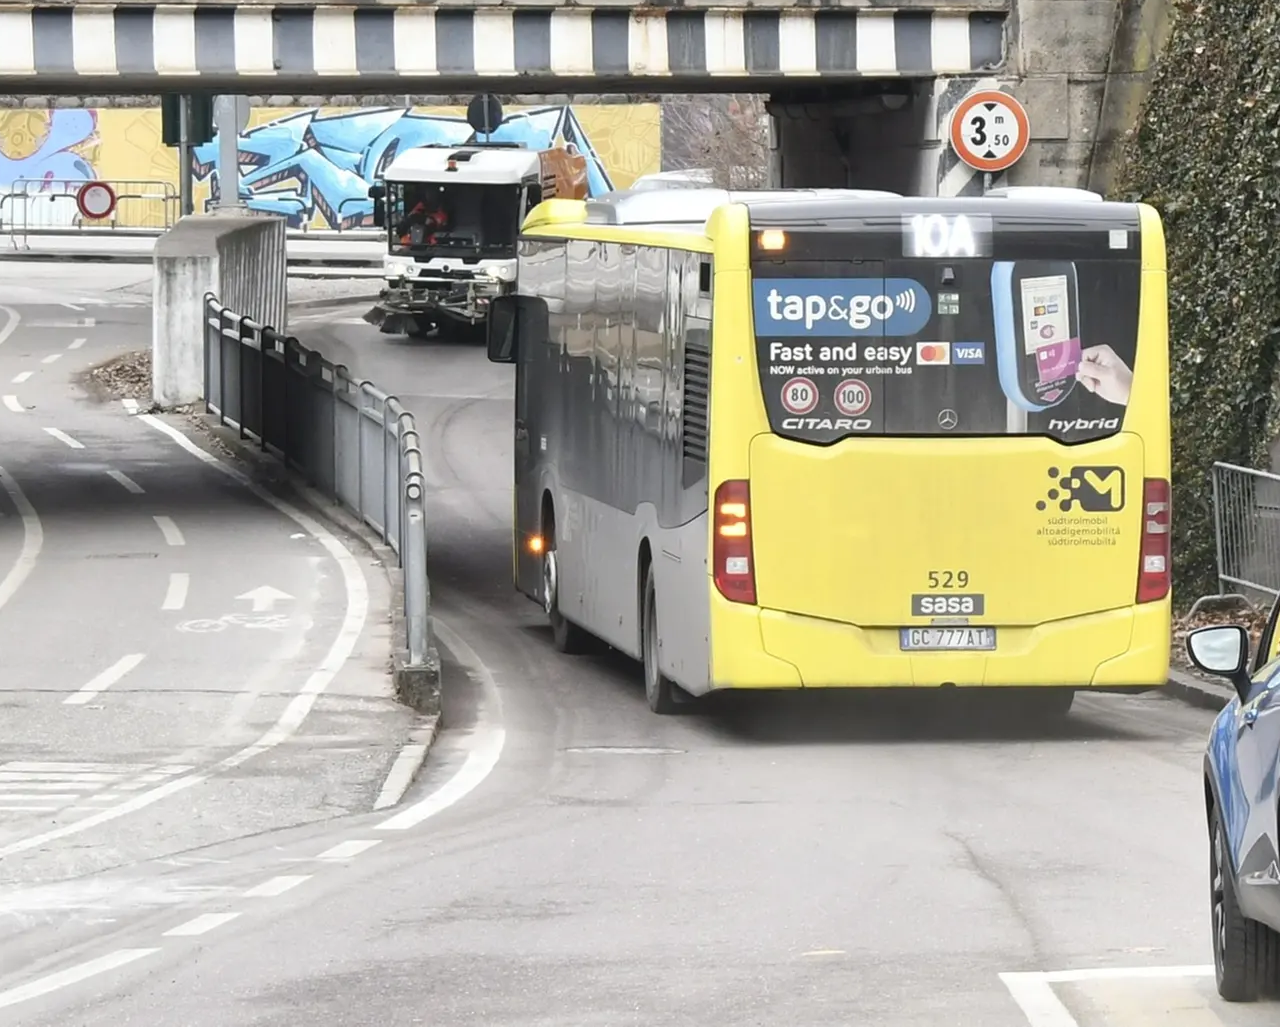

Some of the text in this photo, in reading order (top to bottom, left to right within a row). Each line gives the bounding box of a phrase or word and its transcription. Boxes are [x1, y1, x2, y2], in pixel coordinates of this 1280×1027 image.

[910, 214, 975, 257] 10A
[767, 288, 894, 330] tap&go
[770, 342, 913, 366] Fast and easy
[954, 347, 983, 359] VISA
[770, 365, 913, 377] NOW active on your urban bus
[791, 387, 809, 402] 80
[842, 389, 864, 404] 100
[782, 418, 872, 430] CITARO
[1048, 417, 1120, 433] hybrid
[1047, 517, 1109, 526] südtirolmobil
[928, 570, 970, 589] 529
[920, 596, 974, 614] sasa
[937, 629, 985, 645] 777AT
